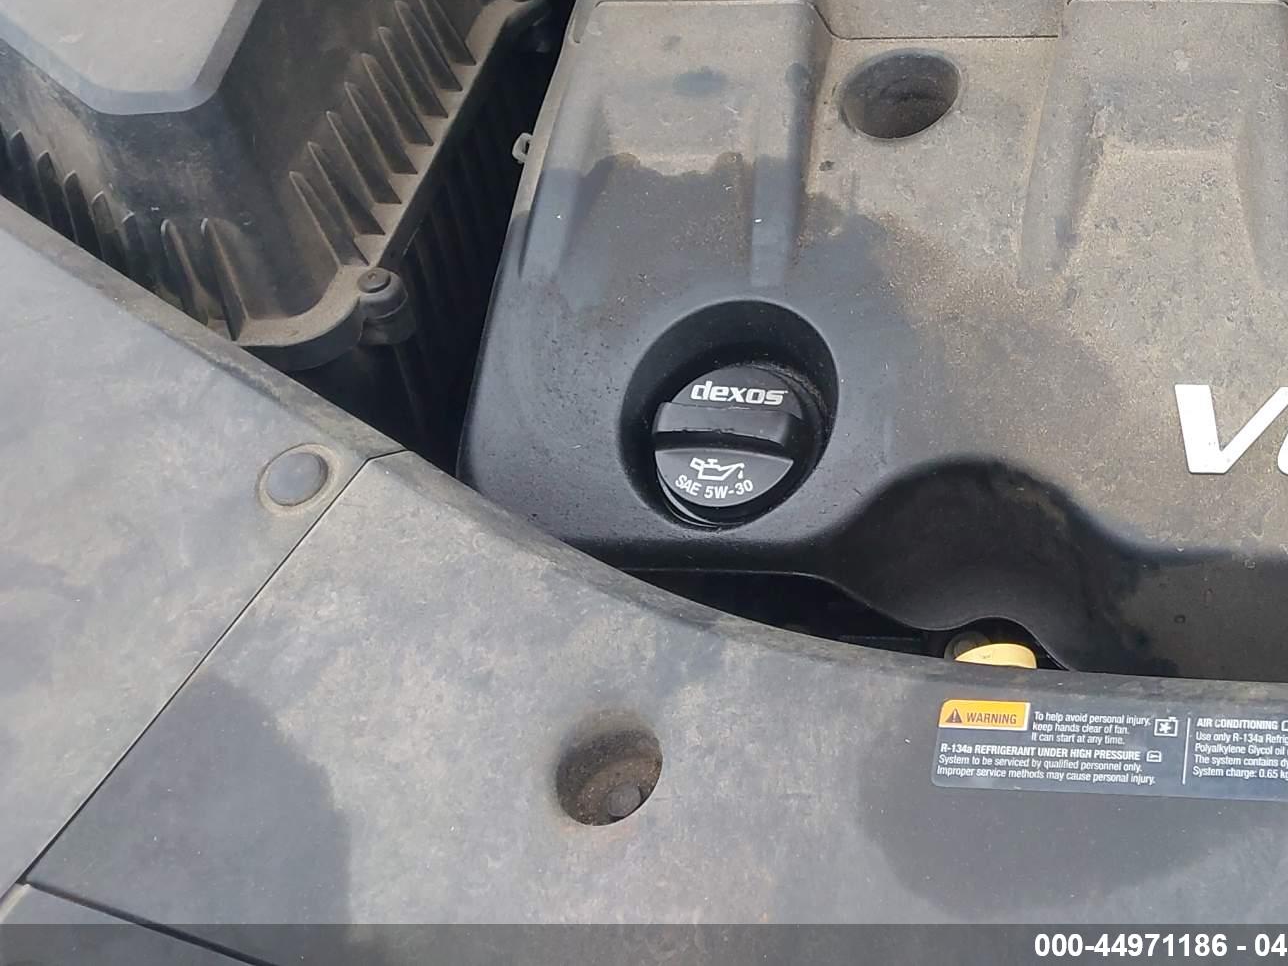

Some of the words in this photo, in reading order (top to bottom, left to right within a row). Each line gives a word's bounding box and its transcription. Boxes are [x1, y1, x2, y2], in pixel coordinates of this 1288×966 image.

[690, 380, 786, 406] dexos
[674, 474, 701, 497] SAE
[703, 479, 754, 499] 5W-30
[966, 712, 1017, 725] WARNING
[1034, 711, 1044, 721] To
[1045, 712, 1063, 722] help
[1065, 713, 1087, 722] avoid
[1089, 715, 1125, 724] personal
[1126, 715, 1151, 726] injury.
[1196, 718, 1213, 728] AIR
[1214, 718, 1278, 731] CONDITIONING
[1032, 723, 1052, 732] keep
[1055, 723, 1080, 733] hands
[1081, 724, 1102, 733] clear
[1104, 724, 1113, 734] of
[1114, 725, 1129, 734] fan.
[1031, 732, 1037, 741] It
[1039, 734, 1054, 742] can
[1056, 734, 1075, 743] start
[1076, 735, 1086, 743] at
[1087, 736, 1103, 745] any
[1104, 735, 1126, 745] time.
[1196, 731, 1211, 741] Use
[1213, 733, 1231, 743] only
[1232, 733, 1264, 743] R-134a
[940, 743, 972, 754] R-134a
[974, 744, 1036, 756] REFRIGERANT
[1037, 746, 1068, 758] UNDER
[1070, 748, 1092, 759] HIGH
[1093, 749, 1141, 761] PRESSURE
[1194, 743, 1246, 755] Polyalkylene
[1247, 745, 1273, 756] Glycol
[1275, 746, 1285, 755] oil
[938, 754, 969, 765] System
[972, 756, 980, 765] to
[982, 756, 993, 765] be
[994, 757, 1029, 767] serviced
[1031, 758, 1042, 769] by
[1043, 759, 1079, 770] qualified
[1080, 761, 1121, 771] personnel
[1123, 763, 1142, 773] only.
[1194, 754, 1210, 764] The
[1211, 756, 1241, 766] system
[1243, 757, 1279, 767] contains
[937, 766, 974, 777] Improper
[976, 767, 1006, 777] service
[1008, 769, 1044, 779] methods
[1046, 771, 1064, 781] may
[1066, 772, 1091, 781] cause
[1093, 773, 1129, 783] personal
[1130, 774, 1156, 786] injury.
[1192, 766, 1224, 777] System
[1225, 768, 1257, 779] charge:
[1258, 769, 1278, 779] 0.65
